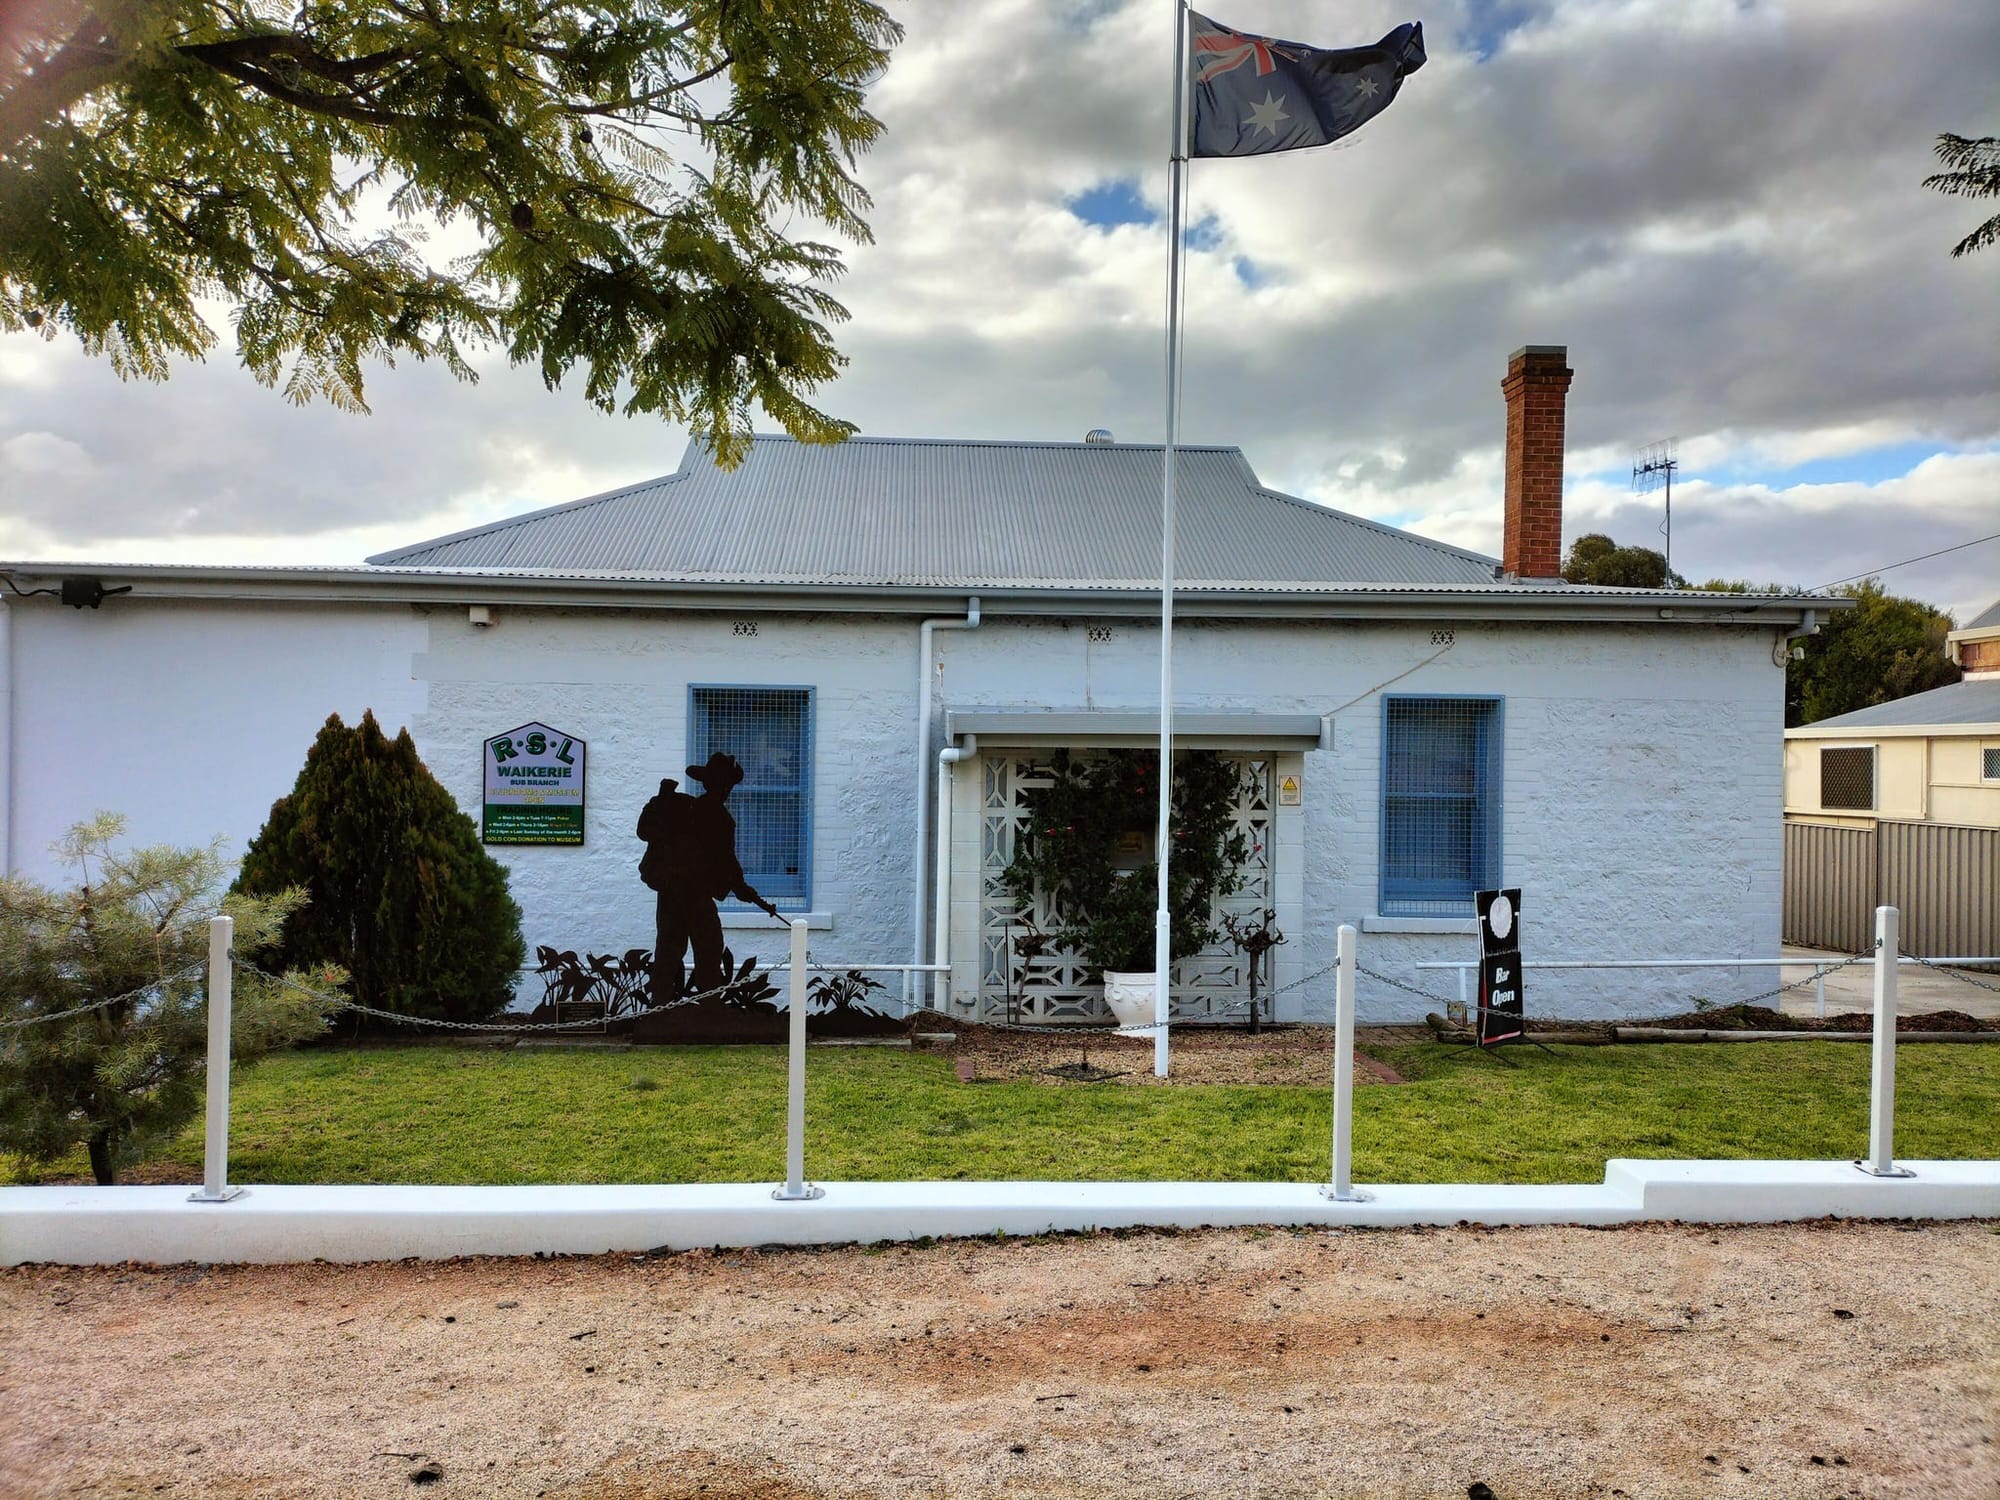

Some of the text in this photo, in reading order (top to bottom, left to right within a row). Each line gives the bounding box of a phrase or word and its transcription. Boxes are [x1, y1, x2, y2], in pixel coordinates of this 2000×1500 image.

[497, 766, 572, 778] WAIKERIE
[496, 806, 573, 815] TRADING HOURS
[1495, 967, 1510, 984] Bar
[1492, 989, 1515, 1007] Open
